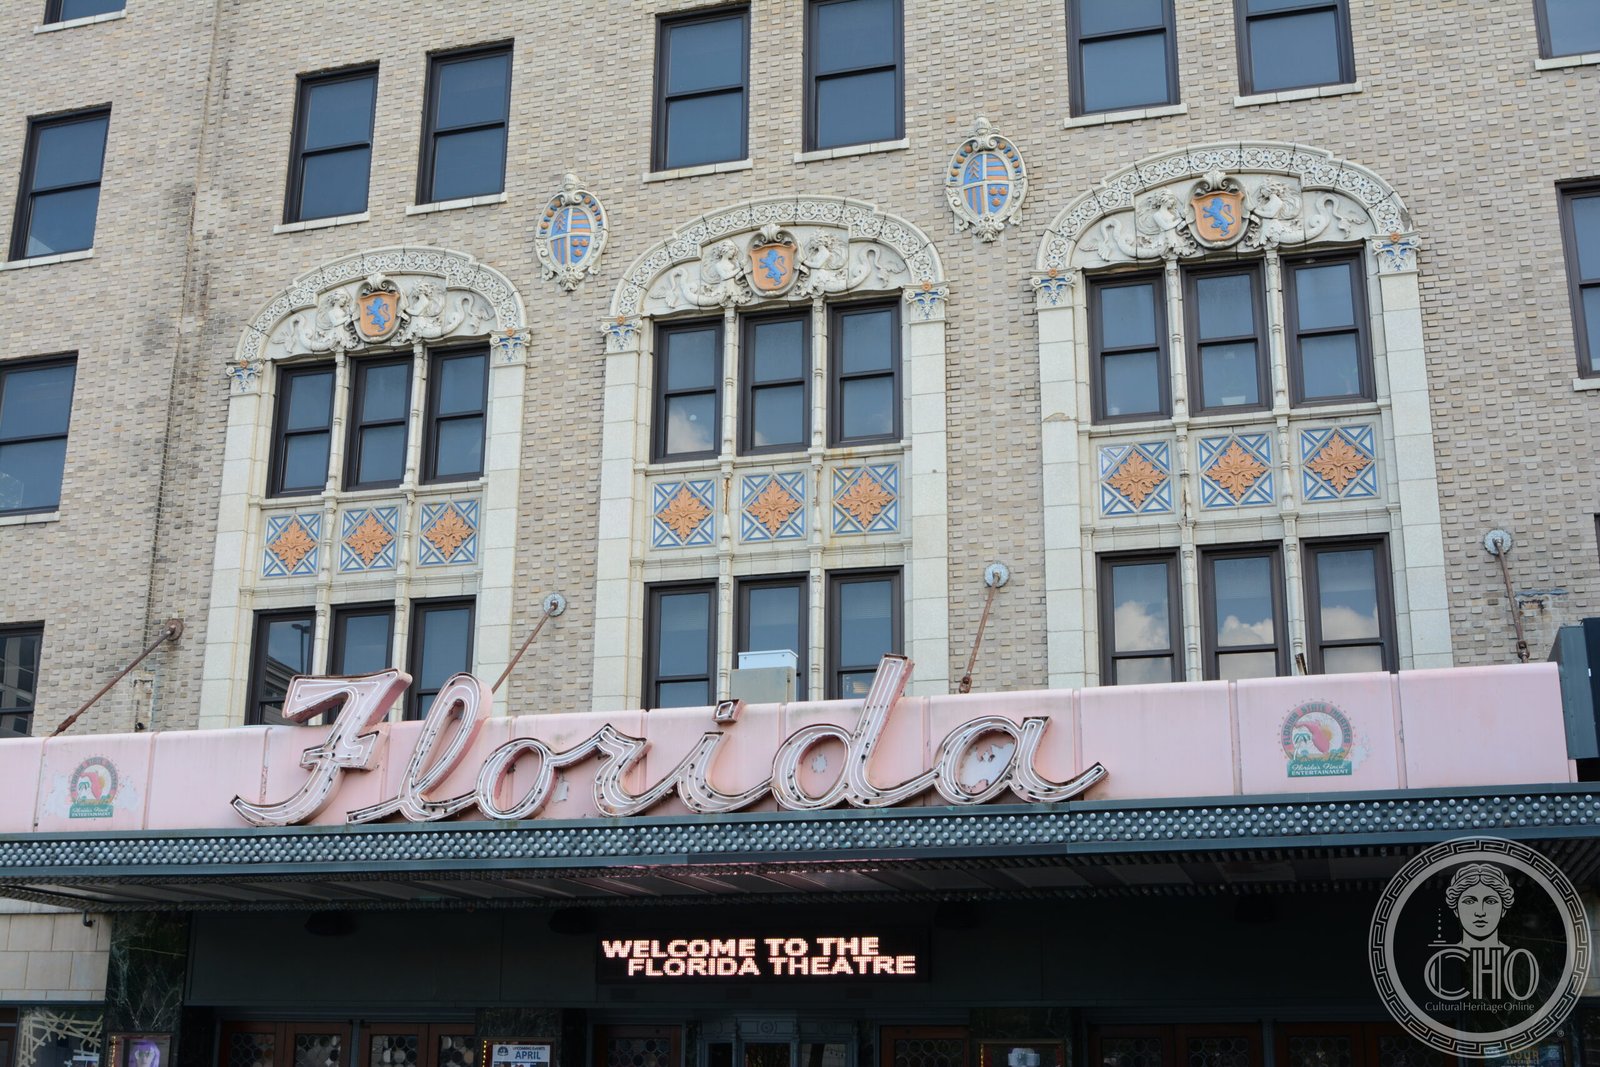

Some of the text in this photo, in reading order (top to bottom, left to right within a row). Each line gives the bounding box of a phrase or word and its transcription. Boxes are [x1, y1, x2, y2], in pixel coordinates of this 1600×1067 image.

[231, 653, 1108, 827] Florida
[602, 937, 879, 958] WELCOME TO THE
[627, 955, 916, 976] FLORIDA THEATRE
[514, 1051, 541, 1060] APRIL
